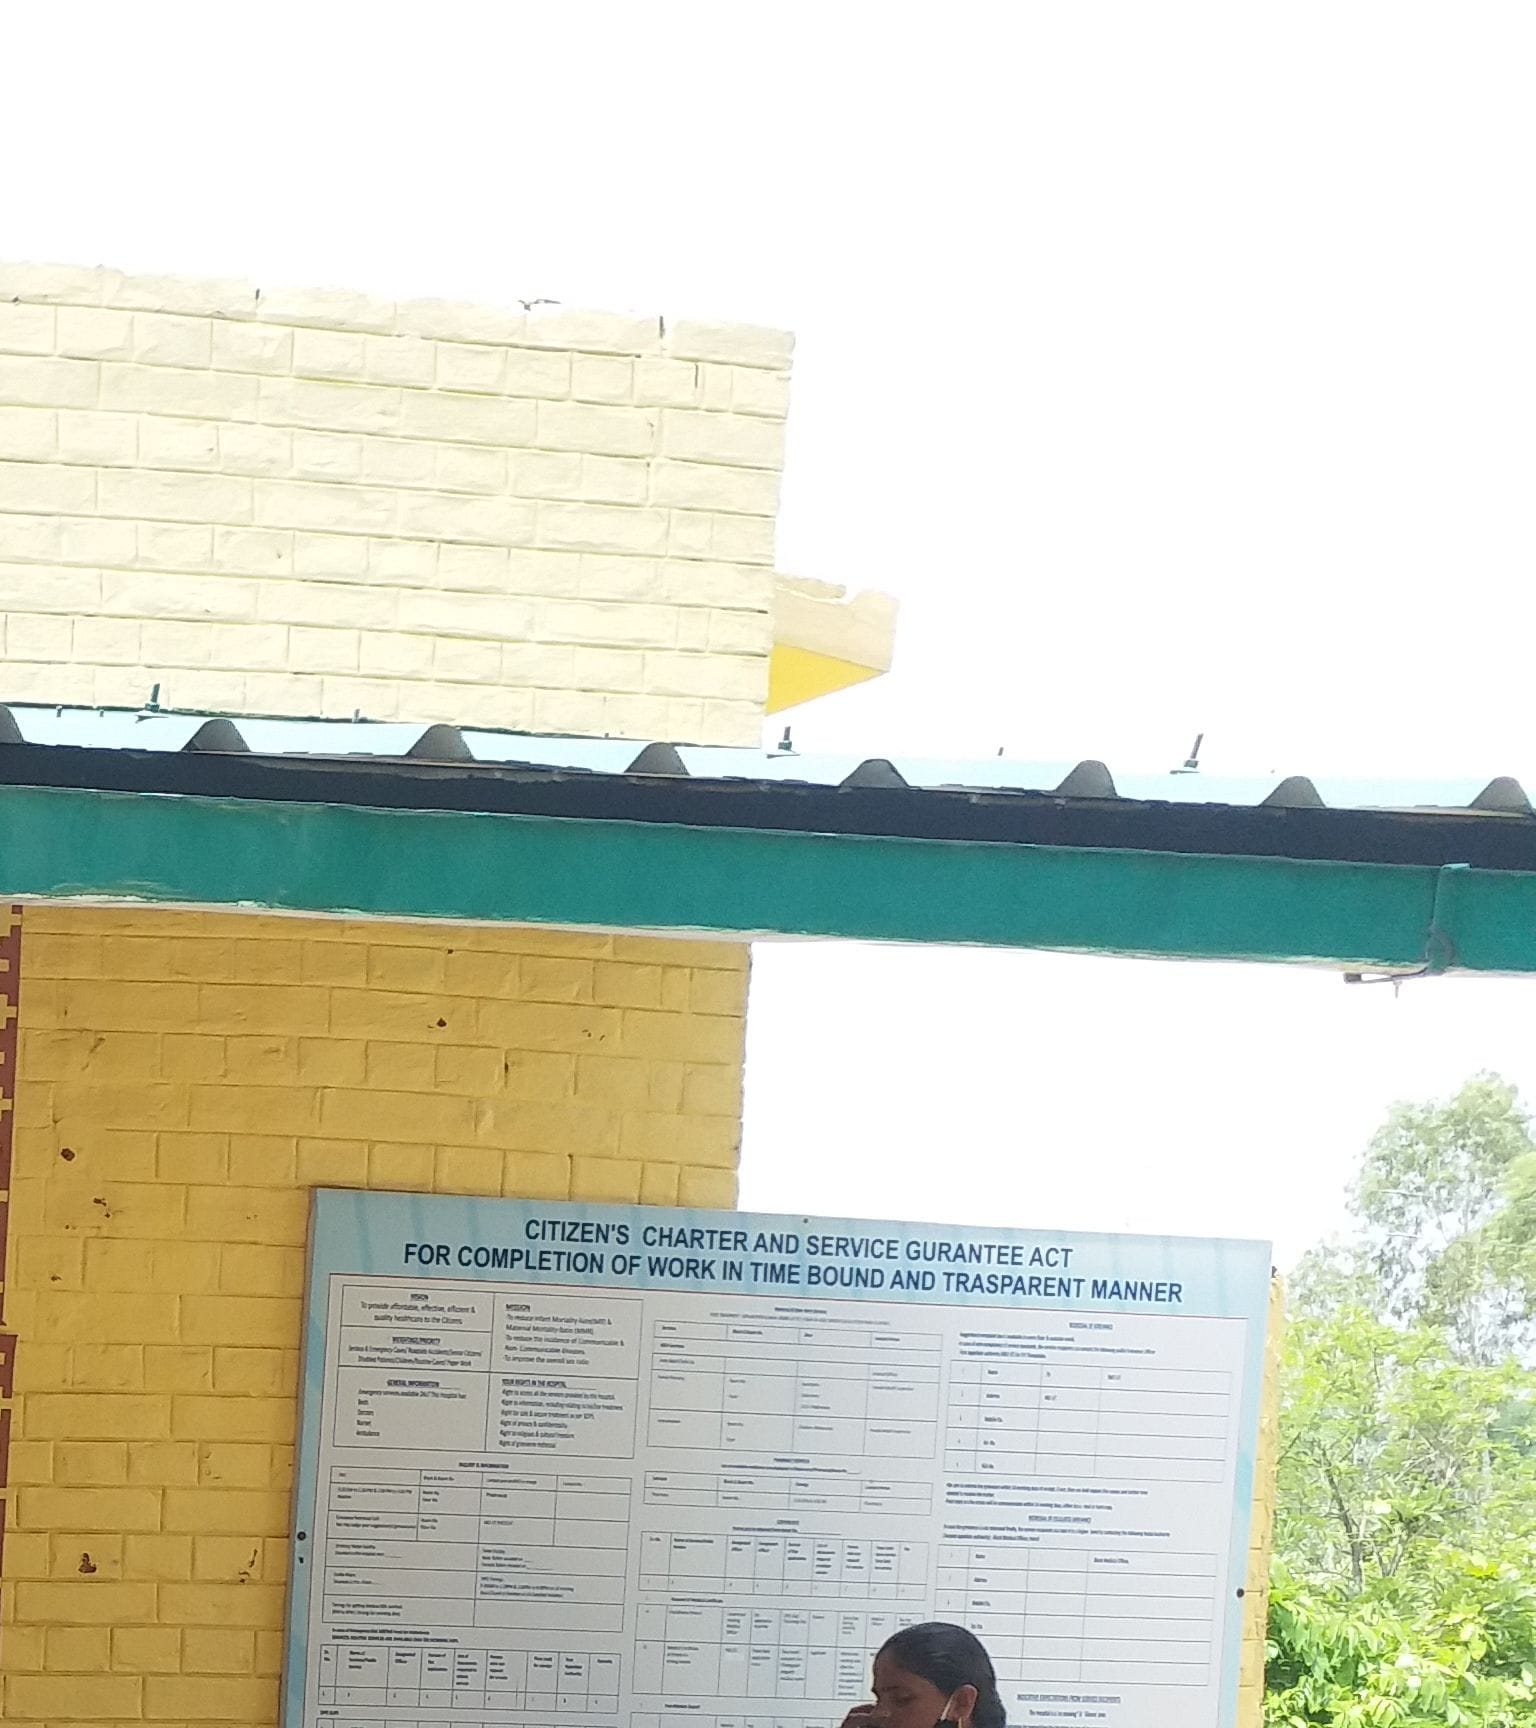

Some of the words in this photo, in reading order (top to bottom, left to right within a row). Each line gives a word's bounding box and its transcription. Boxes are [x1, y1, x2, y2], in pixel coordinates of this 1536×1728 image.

[525, 1219, 629, 1245] CITIZEN'S
[642, 1226, 748, 1251] CHARTER
[754, 1233, 799, 1254] AND
[806, 1235, 899, 1260] SERVICE
[906, 1240, 1024, 1266] GURANTEE
[1029, 1247, 1073, 1268] ACT
[404, 1243, 451, 1266] FOR
[458, 1245, 604, 1274] COMPLETION
[611, 1254, 642, 1276] OF
[648, 1256, 716, 1280] WORK
[722, 1260, 743, 1281] IN
[750, 1262, 800, 1284] TIME
[807, 1265, 885, 1289] BOUND
[890, 1270, 935, 1291] AND
[942, 1272, 1086, 1298] TRASPARENT
[1091, 1279, 1183, 1303] MANNER
